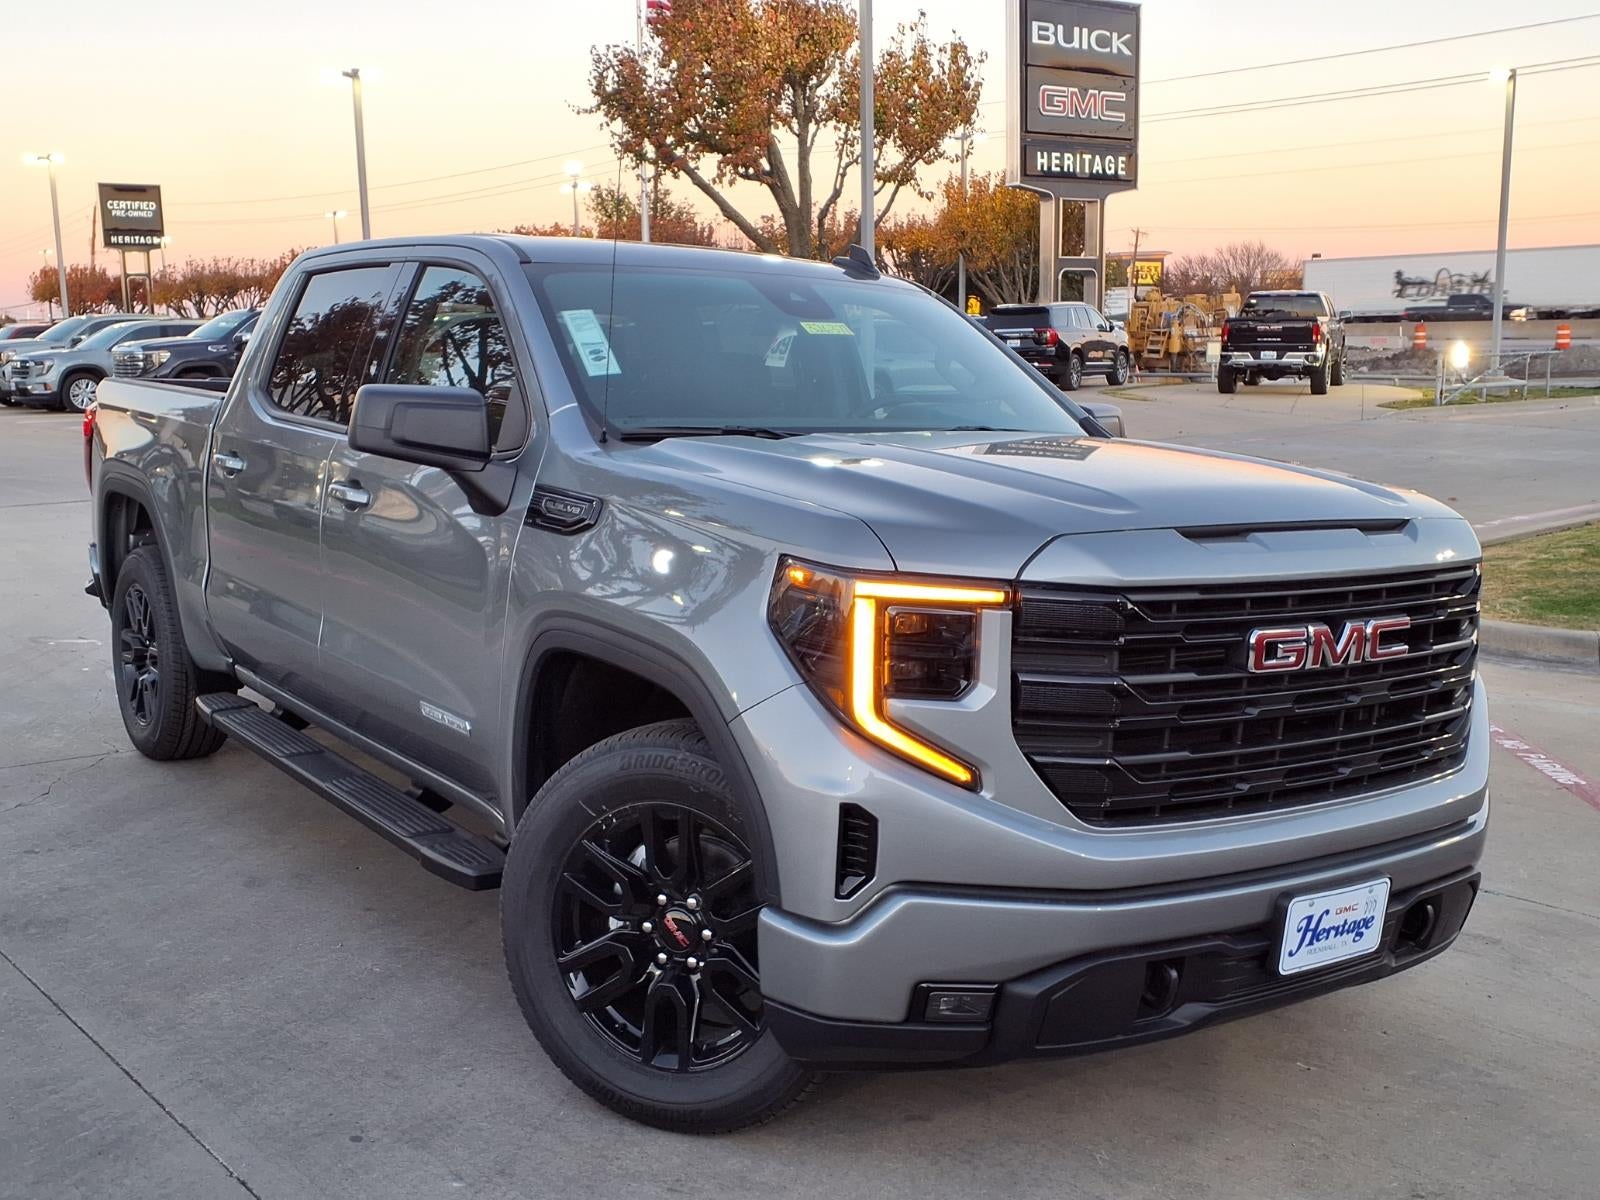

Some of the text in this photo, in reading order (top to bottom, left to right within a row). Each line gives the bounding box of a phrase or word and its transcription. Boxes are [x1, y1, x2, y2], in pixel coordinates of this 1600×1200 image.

[1031, 20, 1133, 56] BUICK
[1040, 85, 1126, 122] GMC
[1036, 151, 1127, 175] HERITAGE
[106, 199, 157, 211] CERTIFIED
[111, 209, 154, 218] PRE-OWNED
[1248, 616, 1411, 673] GMC
[1335, 903, 1359, 916] GMC
[1288, 908, 1375, 958] Heritage
